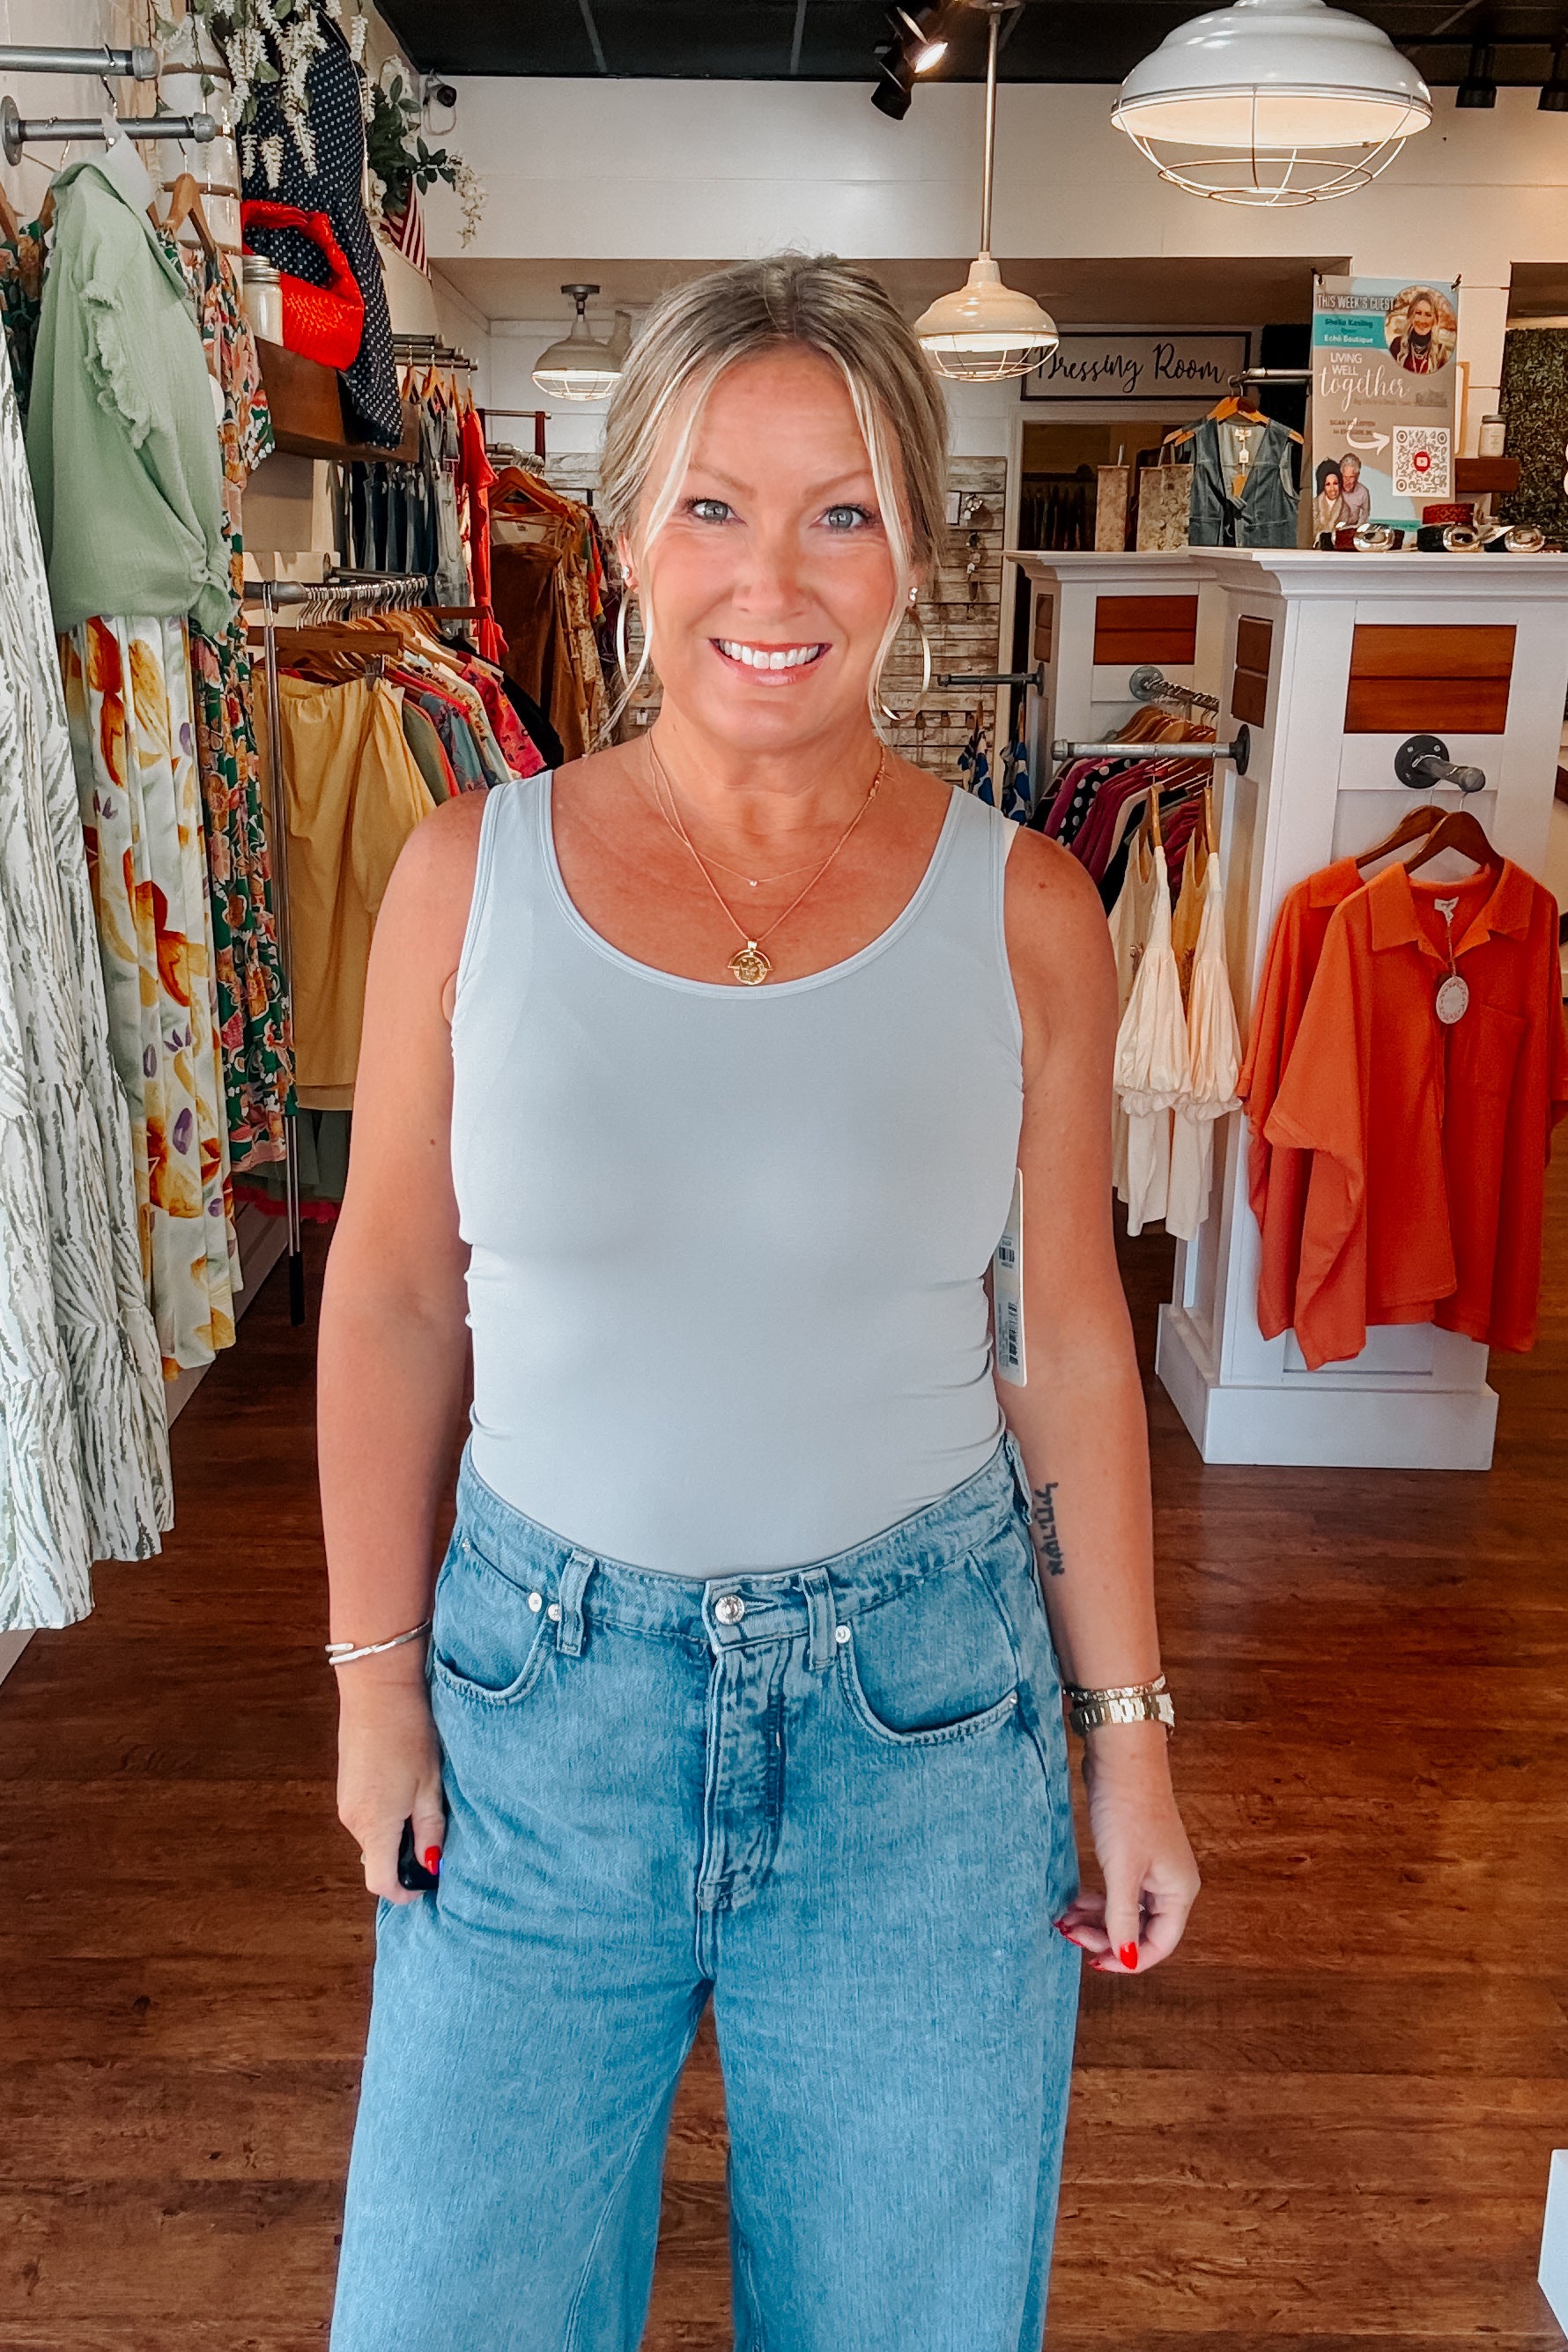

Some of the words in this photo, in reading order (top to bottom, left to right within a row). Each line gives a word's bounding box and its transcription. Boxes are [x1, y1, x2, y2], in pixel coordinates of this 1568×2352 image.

[1317, 294, 1335, 307] THIS
[1337, 295, 1368, 309] WEEK'S
[1330, 352, 1363, 364] LIVING
[1033, 345, 1143, 393] Dressing
[1152, 343, 1225, 383] Room
[1332, 365, 1358, 376] WELL
[1319, 364, 1409, 412] together
